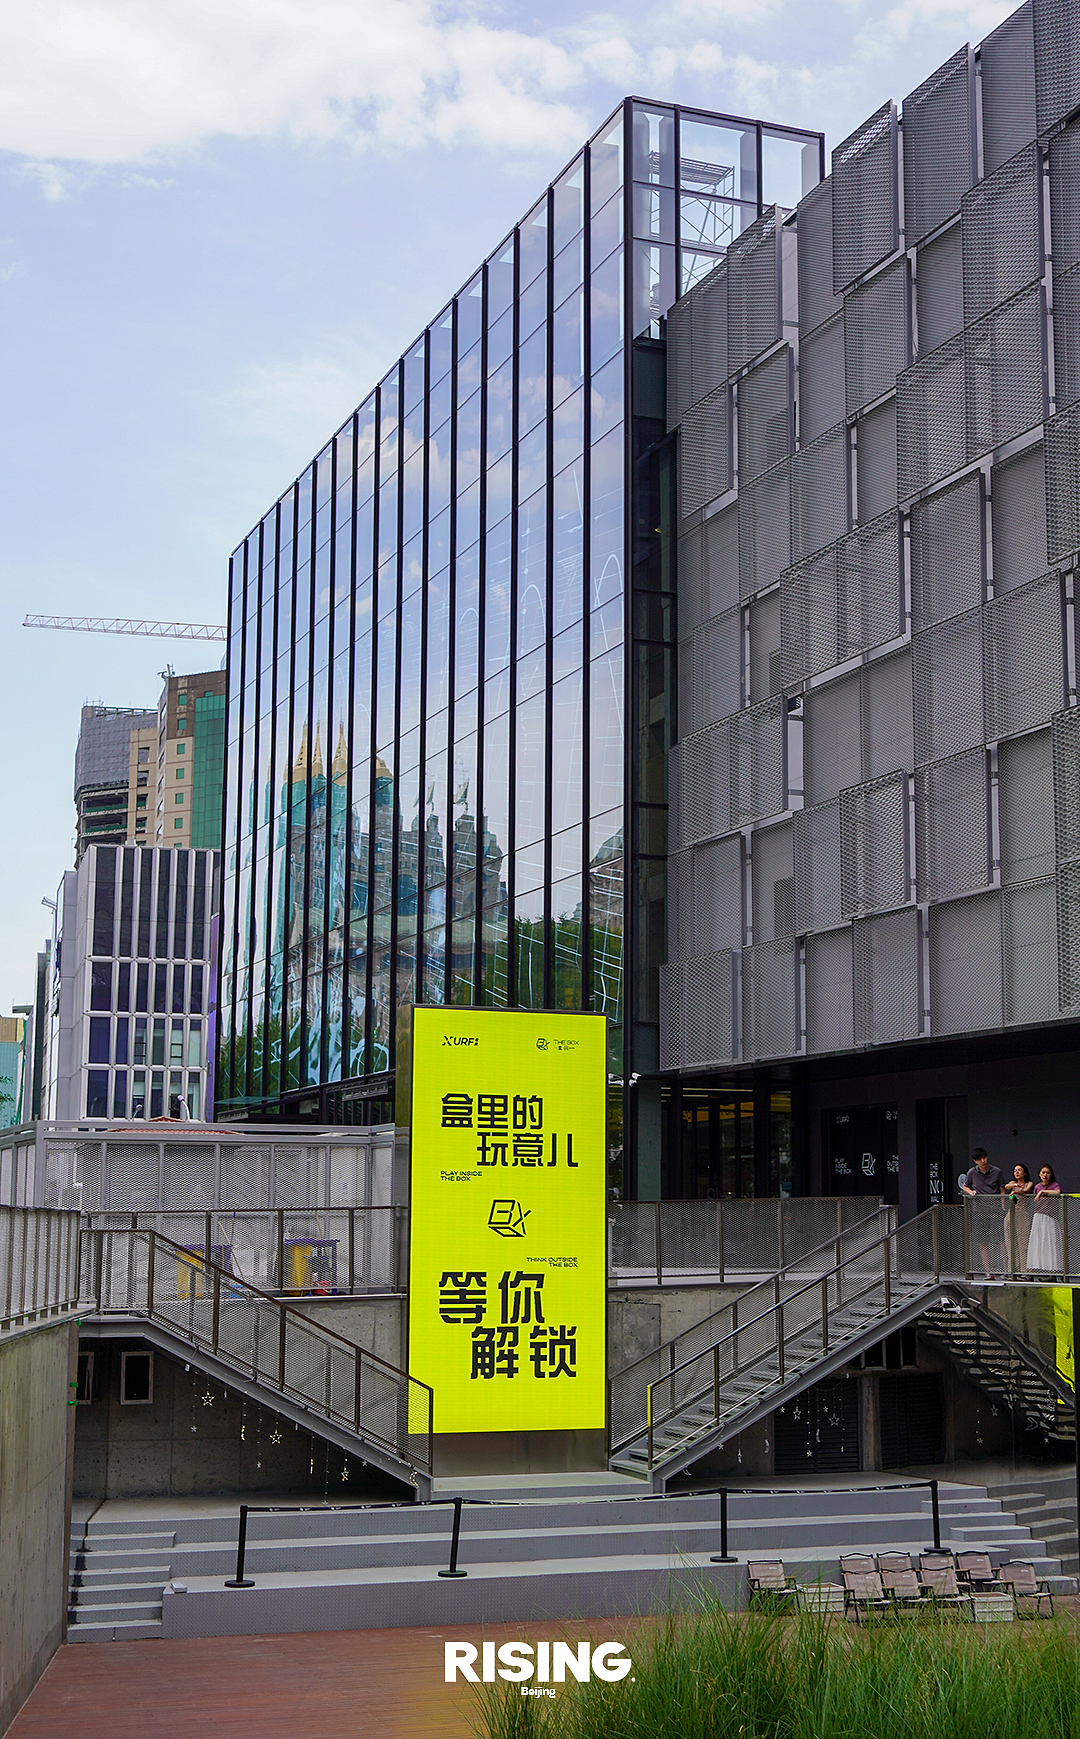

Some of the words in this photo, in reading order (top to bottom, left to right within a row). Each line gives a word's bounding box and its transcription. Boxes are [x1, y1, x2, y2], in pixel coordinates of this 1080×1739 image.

[441, 1093, 543, 1129] 盒里的
[476, 1132, 579, 1167] 玩意儿
[438, 1271, 545, 1324] 等你
[471, 1325, 577, 1379] 解锁
